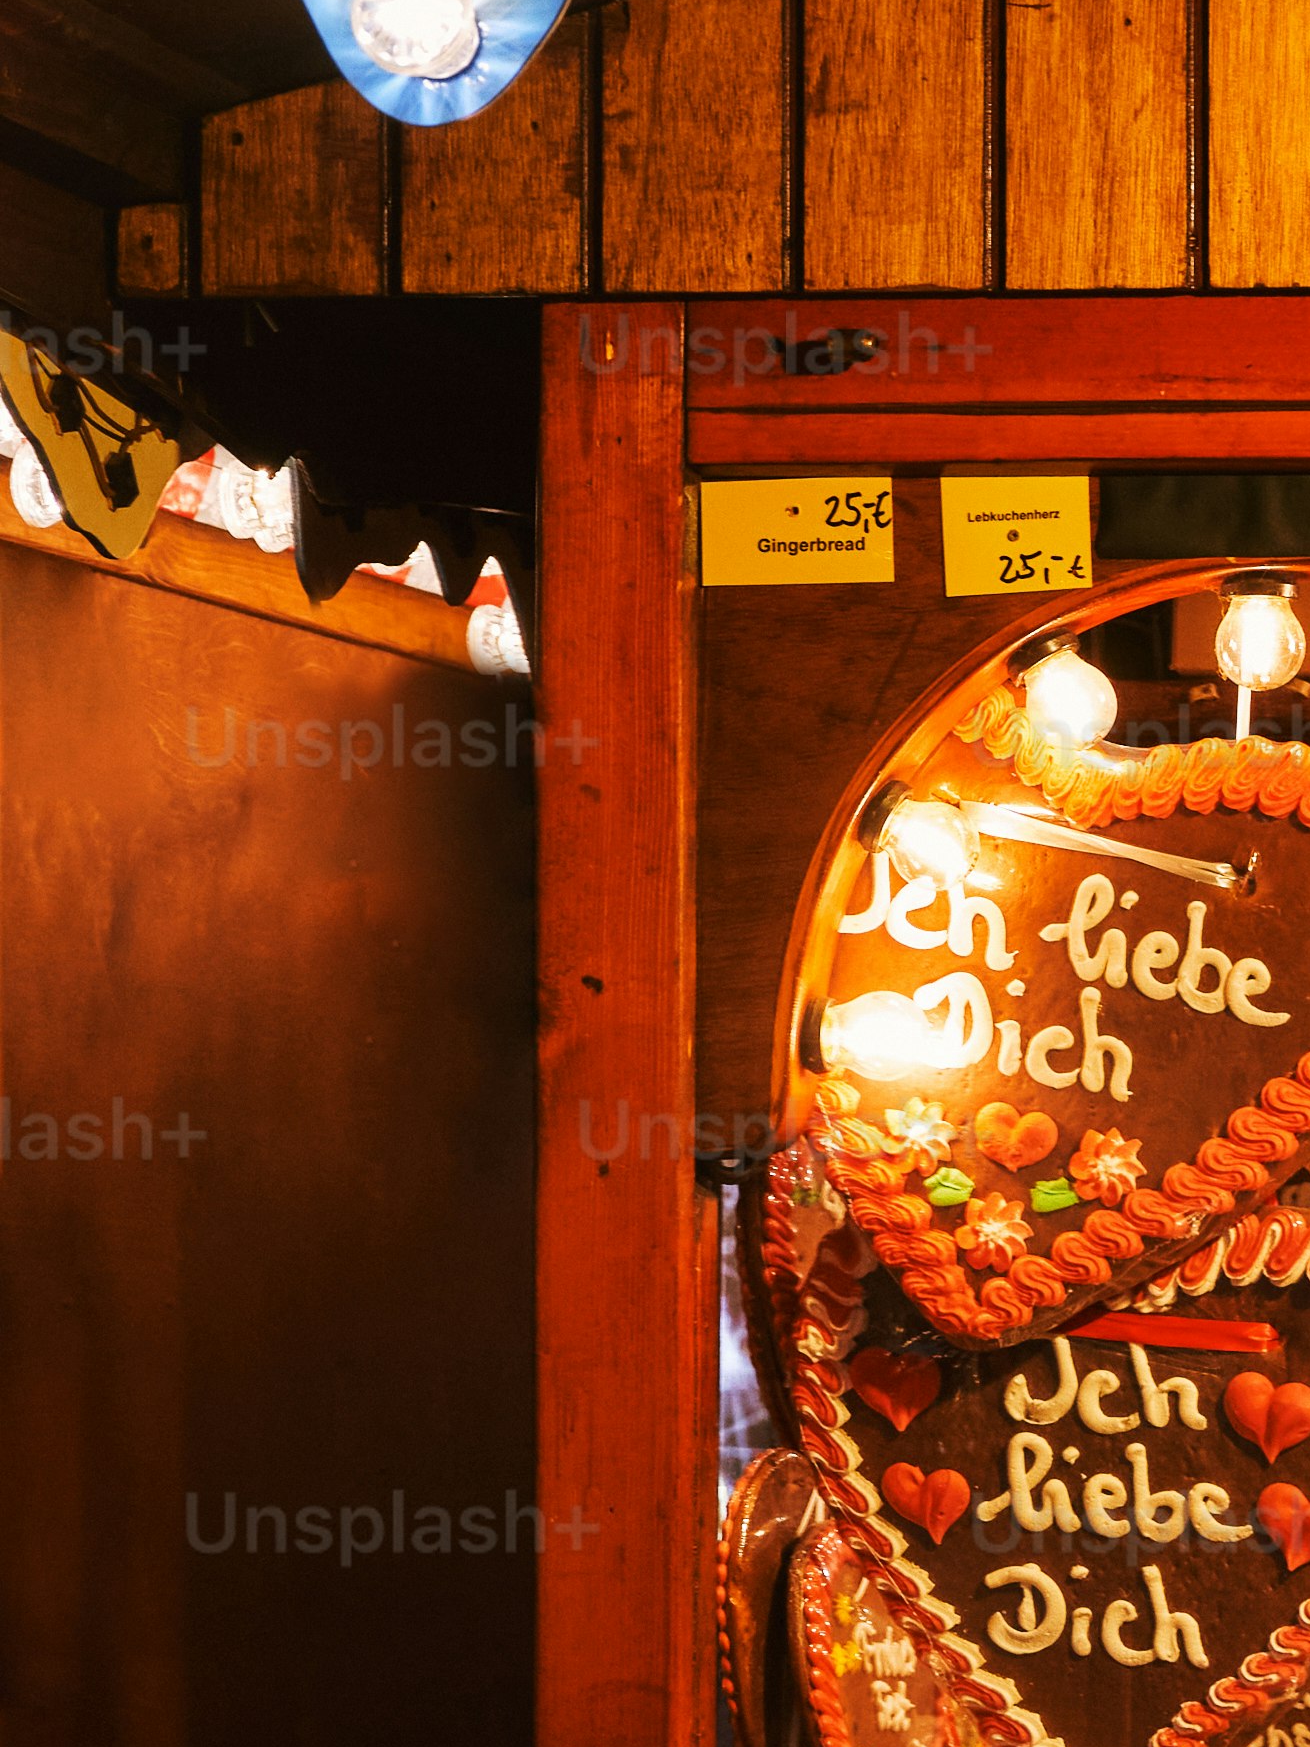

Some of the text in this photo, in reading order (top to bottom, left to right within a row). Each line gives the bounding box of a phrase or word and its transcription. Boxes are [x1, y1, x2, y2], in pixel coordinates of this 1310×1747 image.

[757, 537, 866, 556] Gingerbread
[966, 509, 1061, 523] Lebkuchenherz
[1038, 872, 1292, 1028] liebe
[912, 970, 1133, 1103] Dich
[1003, 1334, 1208, 1435] Ich
[976, 1431, 1256, 1544] liebe
[983, 1561, 1210, 1670] Dich
